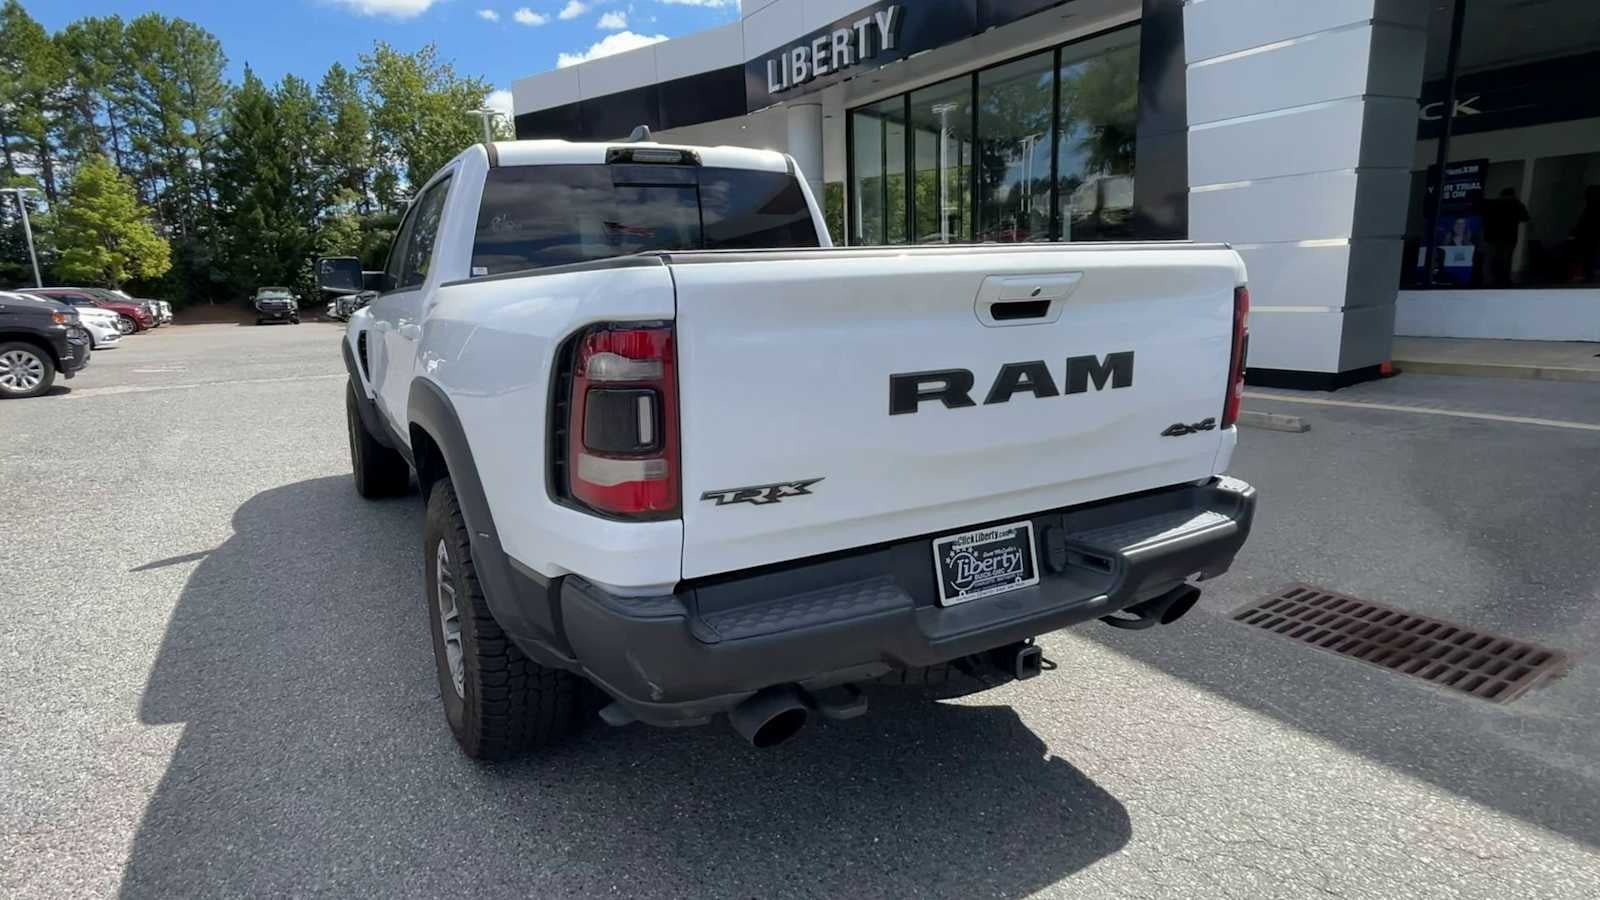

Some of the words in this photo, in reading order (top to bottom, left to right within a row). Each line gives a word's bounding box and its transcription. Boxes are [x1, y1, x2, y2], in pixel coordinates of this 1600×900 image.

[767, 5, 900, 94] LIBERTY
[889, 351, 1135, 416] RAM
[699, 477, 826, 506] TRX
[956, 551, 1020, 584] Liberty
